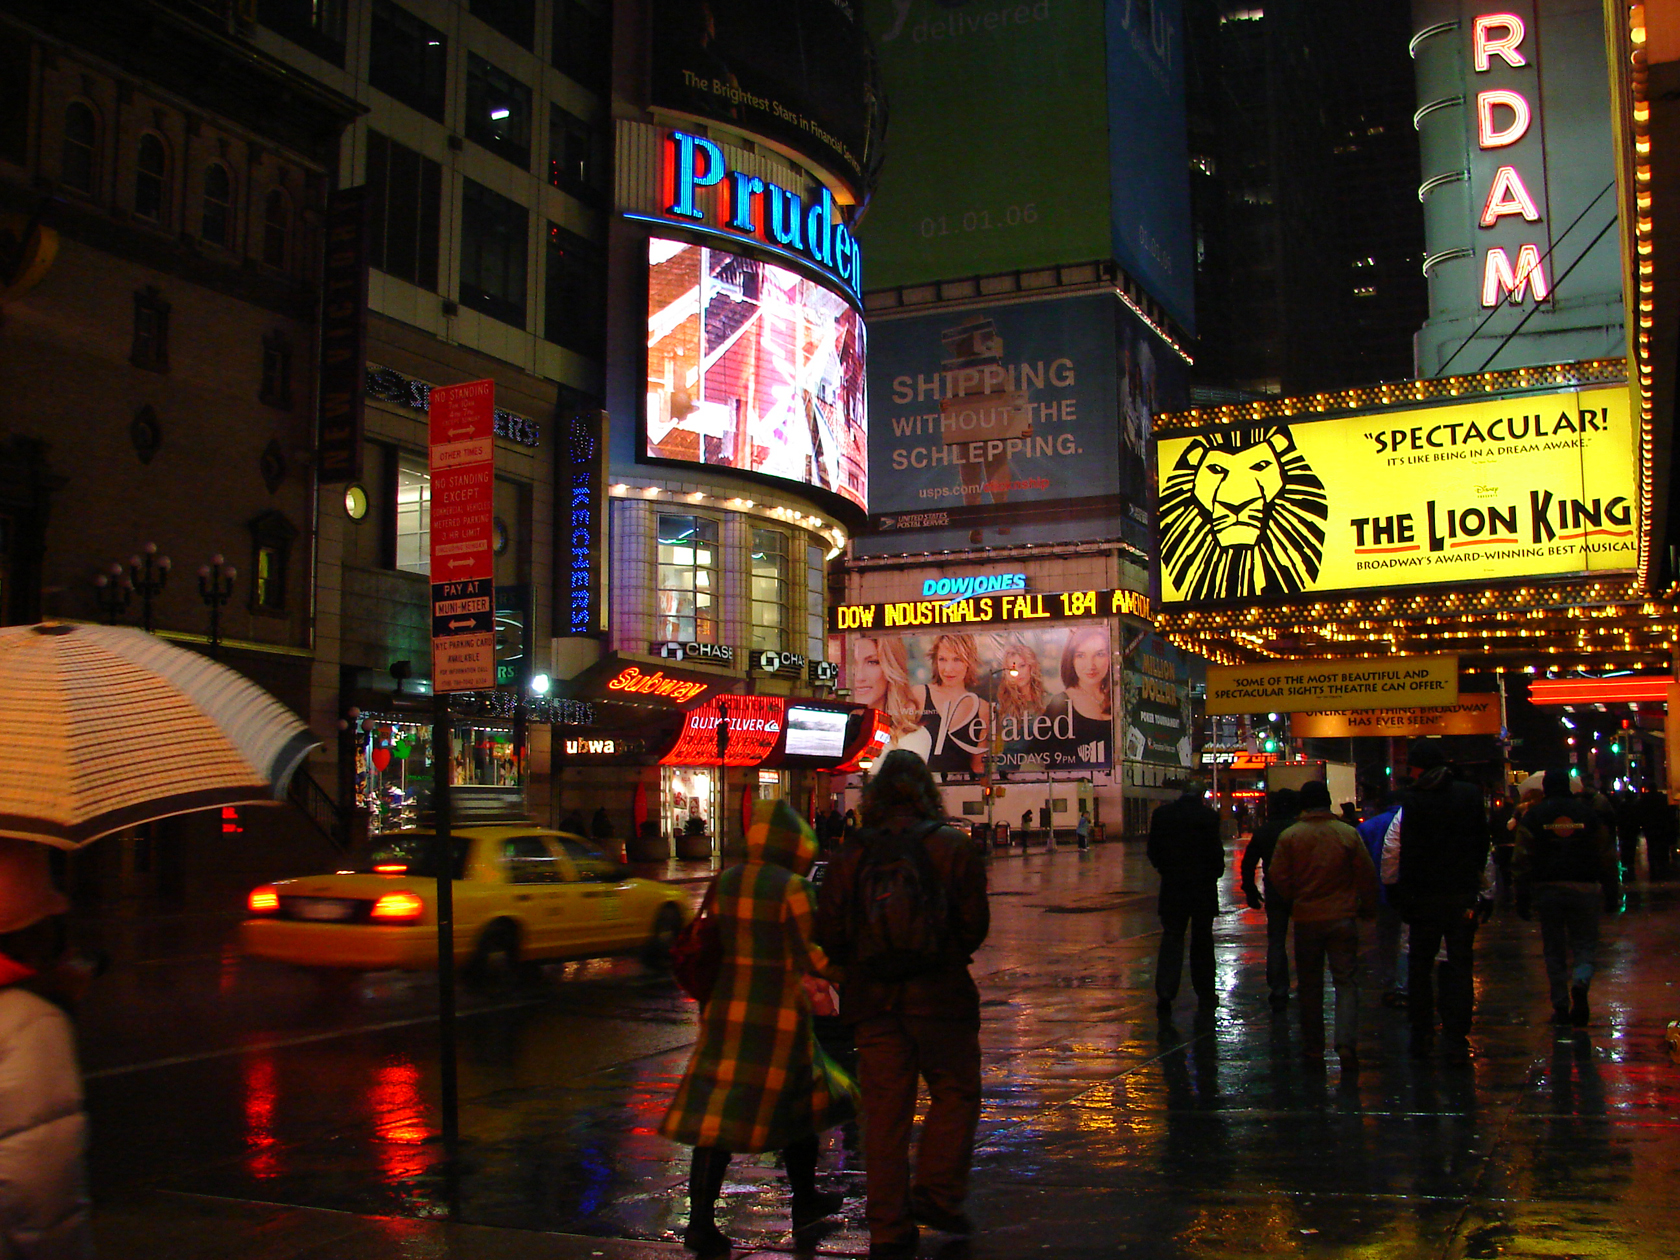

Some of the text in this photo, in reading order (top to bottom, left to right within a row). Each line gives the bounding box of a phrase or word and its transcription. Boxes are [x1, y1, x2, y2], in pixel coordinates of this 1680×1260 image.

[682, 69, 708, 92] The
[713, 79, 770, 112] Brightest
[772, 100, 798, 125] Stars
[799, 113, 809, 131] in
[921, 203, 1038, 238] 01.01.06
[892, 357, 1075, 405] SHIPPING
[435, 384, 489, 403] NO STANDING
[892, 399, 1077, 437] WITHOUT THE
[440, 447, 483, 461] OTHER TIMES
[892, 433, 1084, 470] SCHLEPPING.
[1387, 456, 1404, 467] IT'S
[1408, 454, 1430, 464] LIKE
[1434, 451, 1466, 462] BEING
[1470, 449, 1482, 458] IN
[1486, 448, 1494, 456] A
[1497, 443, 1541, 456] DREAM
[435, 472, 489, 489] NO STANDING
[444, 488, 479, 503] EXCEPT
[1351, 489, 1633, 552] THE LION KING
[1356, 540, 1637, 571] BROADWAY'S AWARD-WINNING BEST MUSICAL
[444, 582, 480, 597] PAY AT
[438, 600, 487, 615] MUNI-METER
[838, 605, 875, 629] DOW
[885, 598, 993, 626] INDUSTRIALS
[1002, 595, 1050, 619] FALL
[449, 639, 474, 649] PARKING
[686, 642, 733, 660] CHASE
[609, 666, 708, 702] Subway
[1268, 676, 1282, 686] OF
[1285, 675, 1305, 685] THE
[1307, 673, 1339, 684] MOST
[1341, 671, 1401, 682] BEAUTIFUL
[1403, 669, 1429, 680] AND
[1215, 686, 1284, 699] SPECTACULAR
[1287, 684, 1324, 696] SIGHTS
[1326, 681, 1378, 694] THEATRE
[1381, 681, 1407, 692] CAN
[1417, 702, 1489, 715] BROADWAY
[934, 692, 1076, 755] Related
[1348, 717, 1372, 727] HAS
[1376, 716, 1405, 726] EVER
